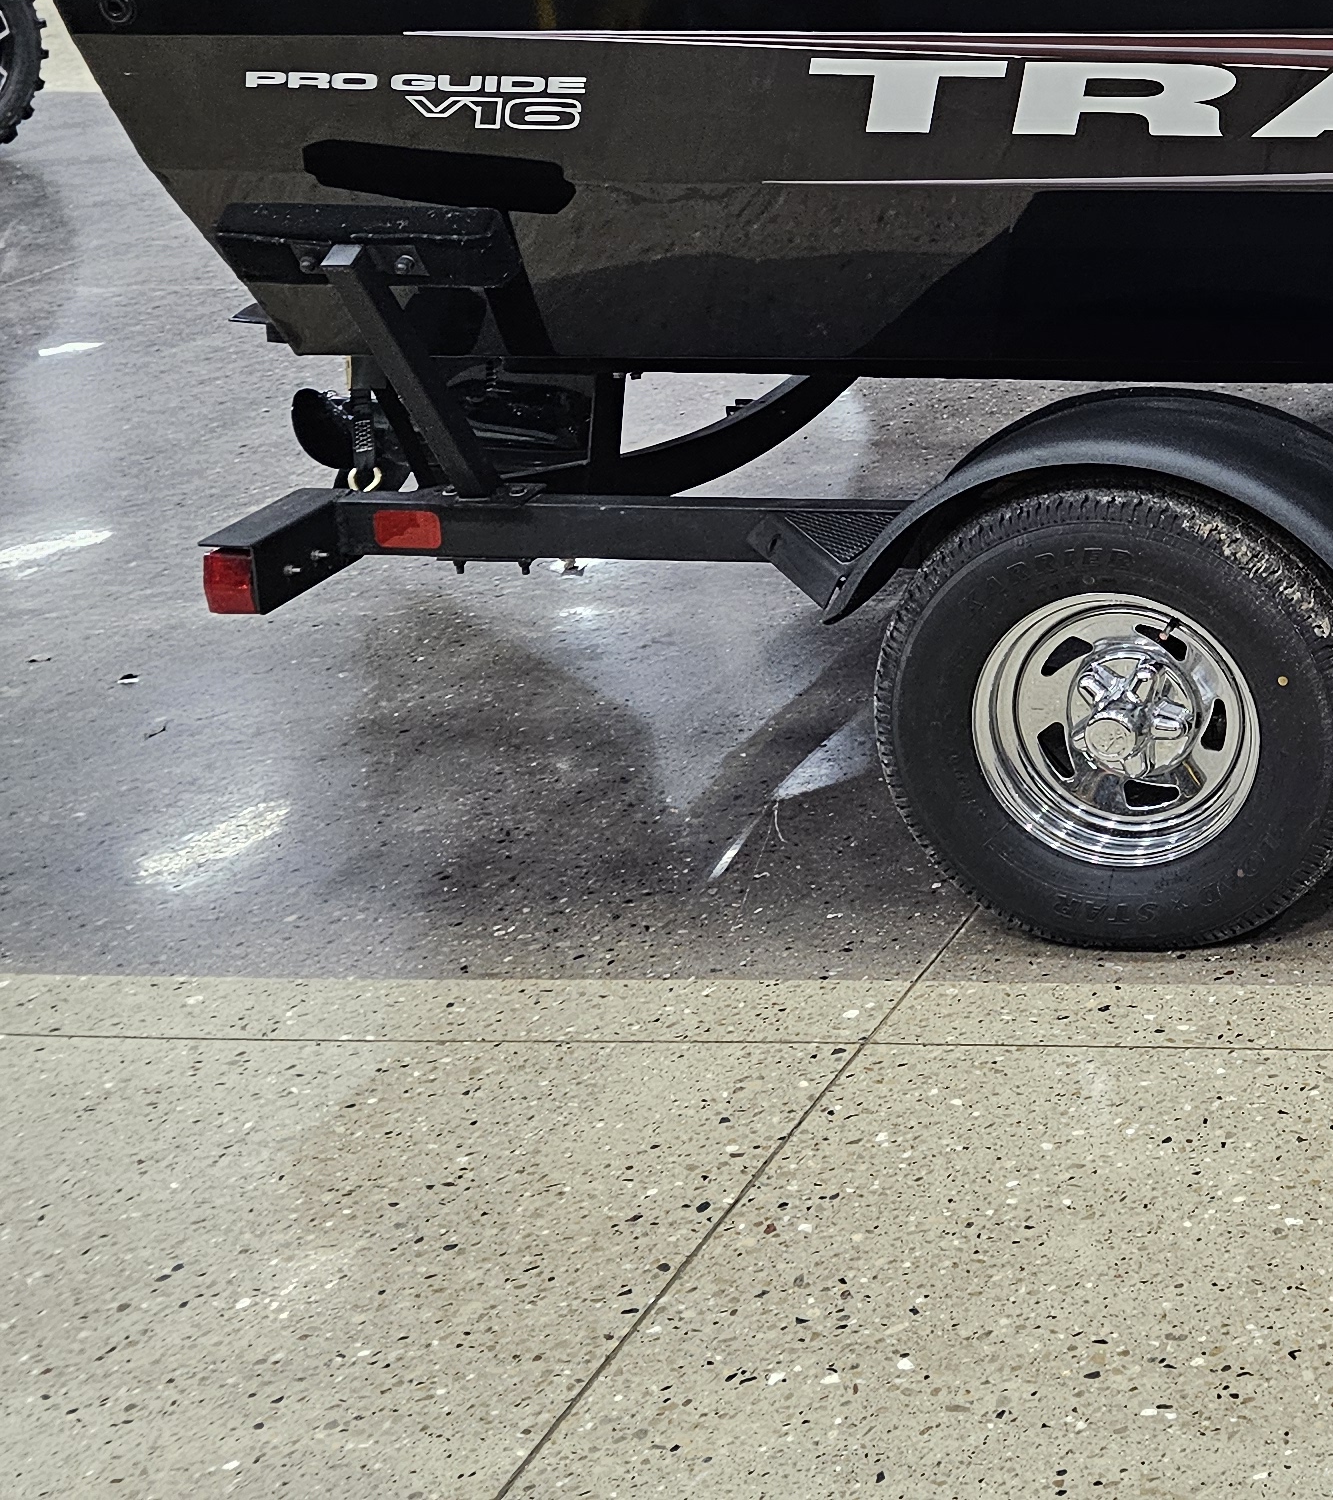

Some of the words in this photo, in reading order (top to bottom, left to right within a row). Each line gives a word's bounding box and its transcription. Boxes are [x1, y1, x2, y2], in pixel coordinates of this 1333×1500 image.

[245, 71, 378, 90] PRO
[390, 73, 587, 94] GUIDE
[404, 95, 582, 130] V16
